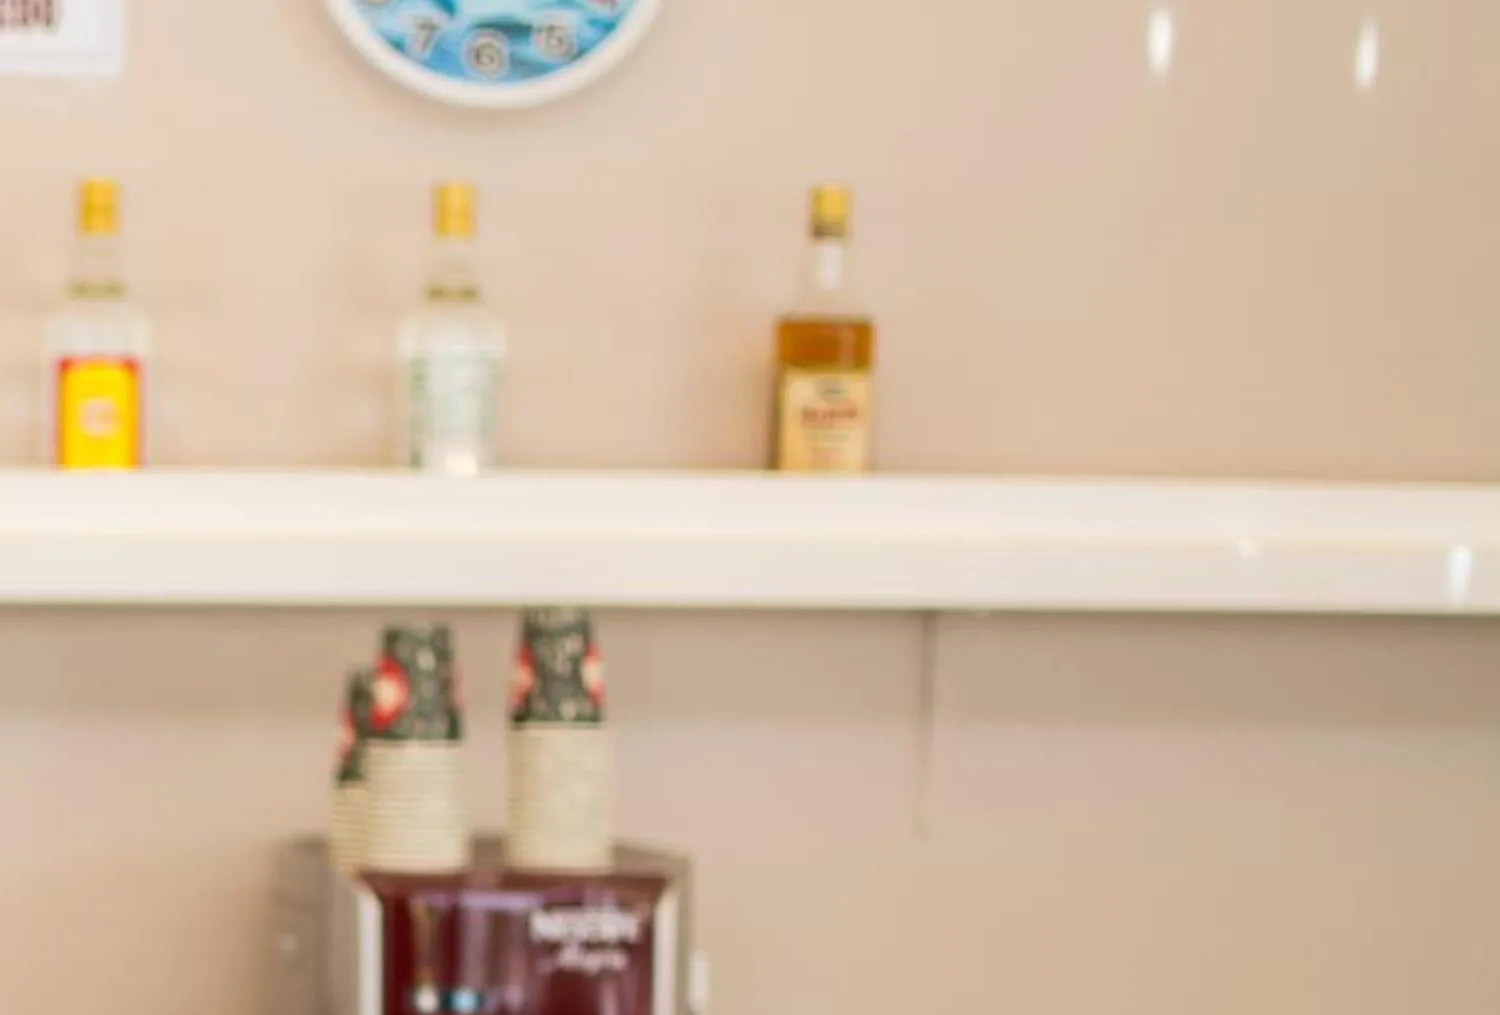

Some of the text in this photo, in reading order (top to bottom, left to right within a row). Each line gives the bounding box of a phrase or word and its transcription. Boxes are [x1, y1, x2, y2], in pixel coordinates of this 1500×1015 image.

[413, 20, 437, 51] 7
[545, 24, 567, 50] 5
[474, 40, 499, 66] 6
